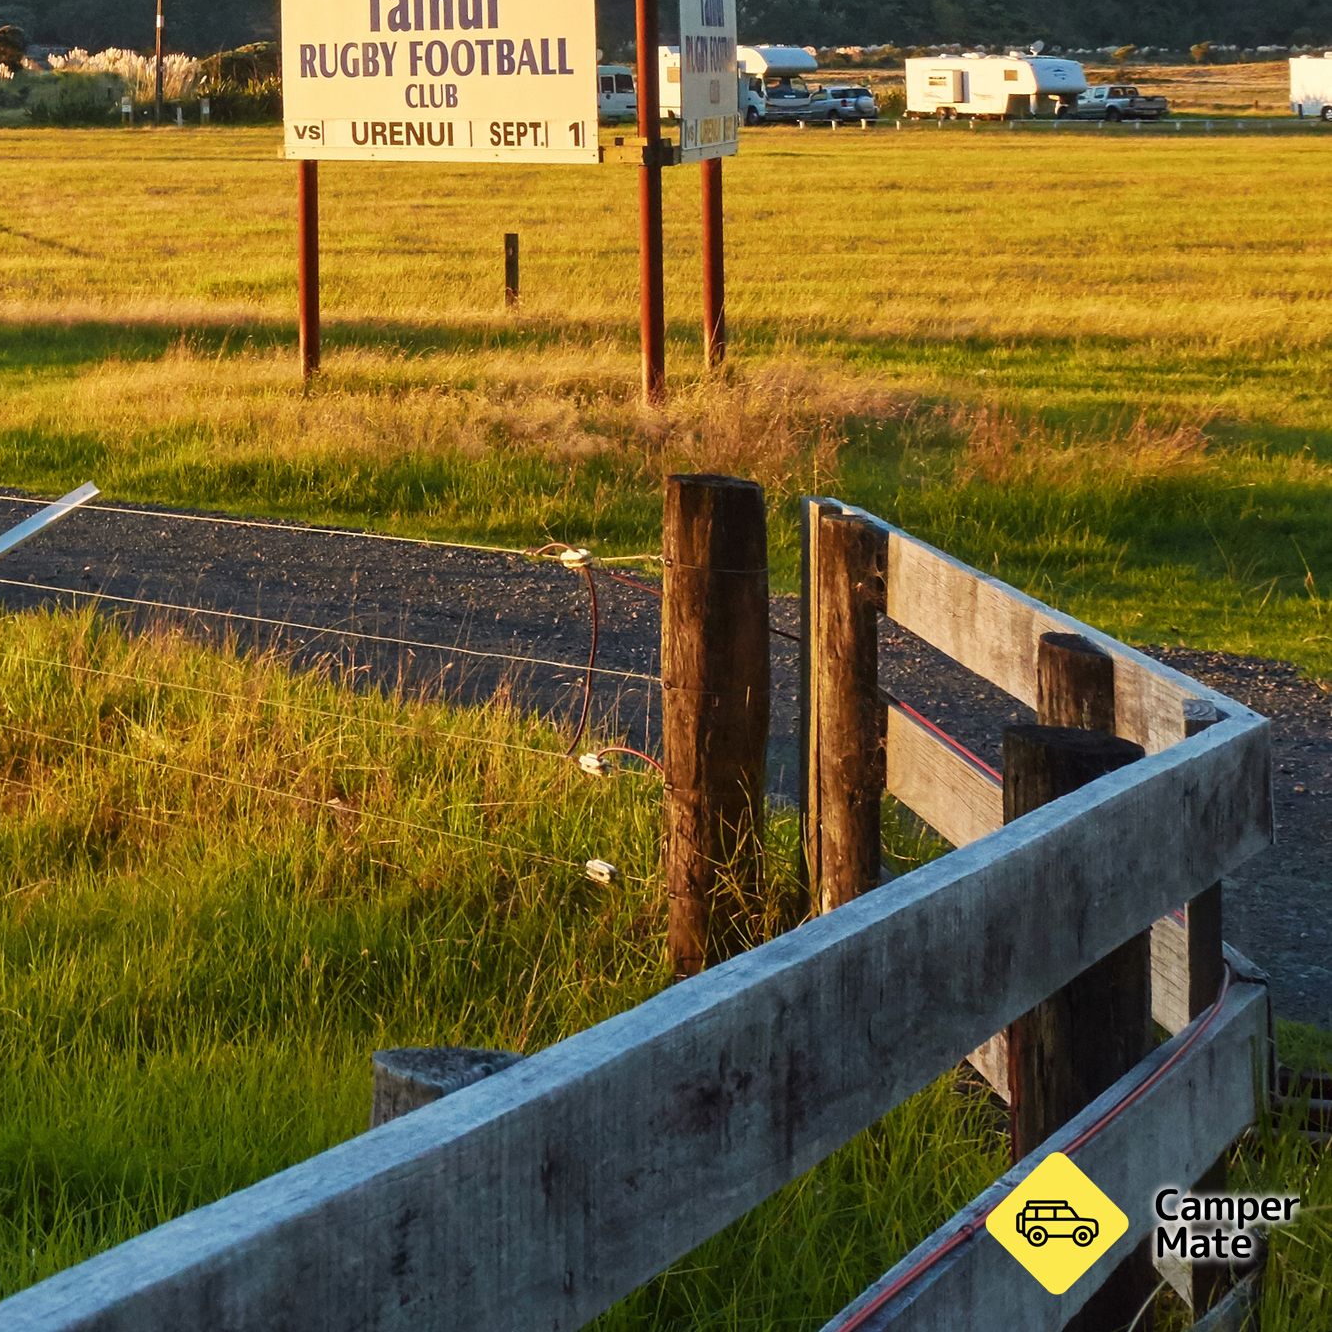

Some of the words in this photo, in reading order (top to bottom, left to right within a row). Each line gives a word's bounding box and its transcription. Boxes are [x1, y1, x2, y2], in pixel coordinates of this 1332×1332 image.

[299, 41, 398, 78] RUGBY
[409, 37, 575, 77] FOOTBALL
[405, 83, 459, 109] CLUB
[351, 121, 454, 146] URENUI
[489, 121, 545, 147] SEPT.
